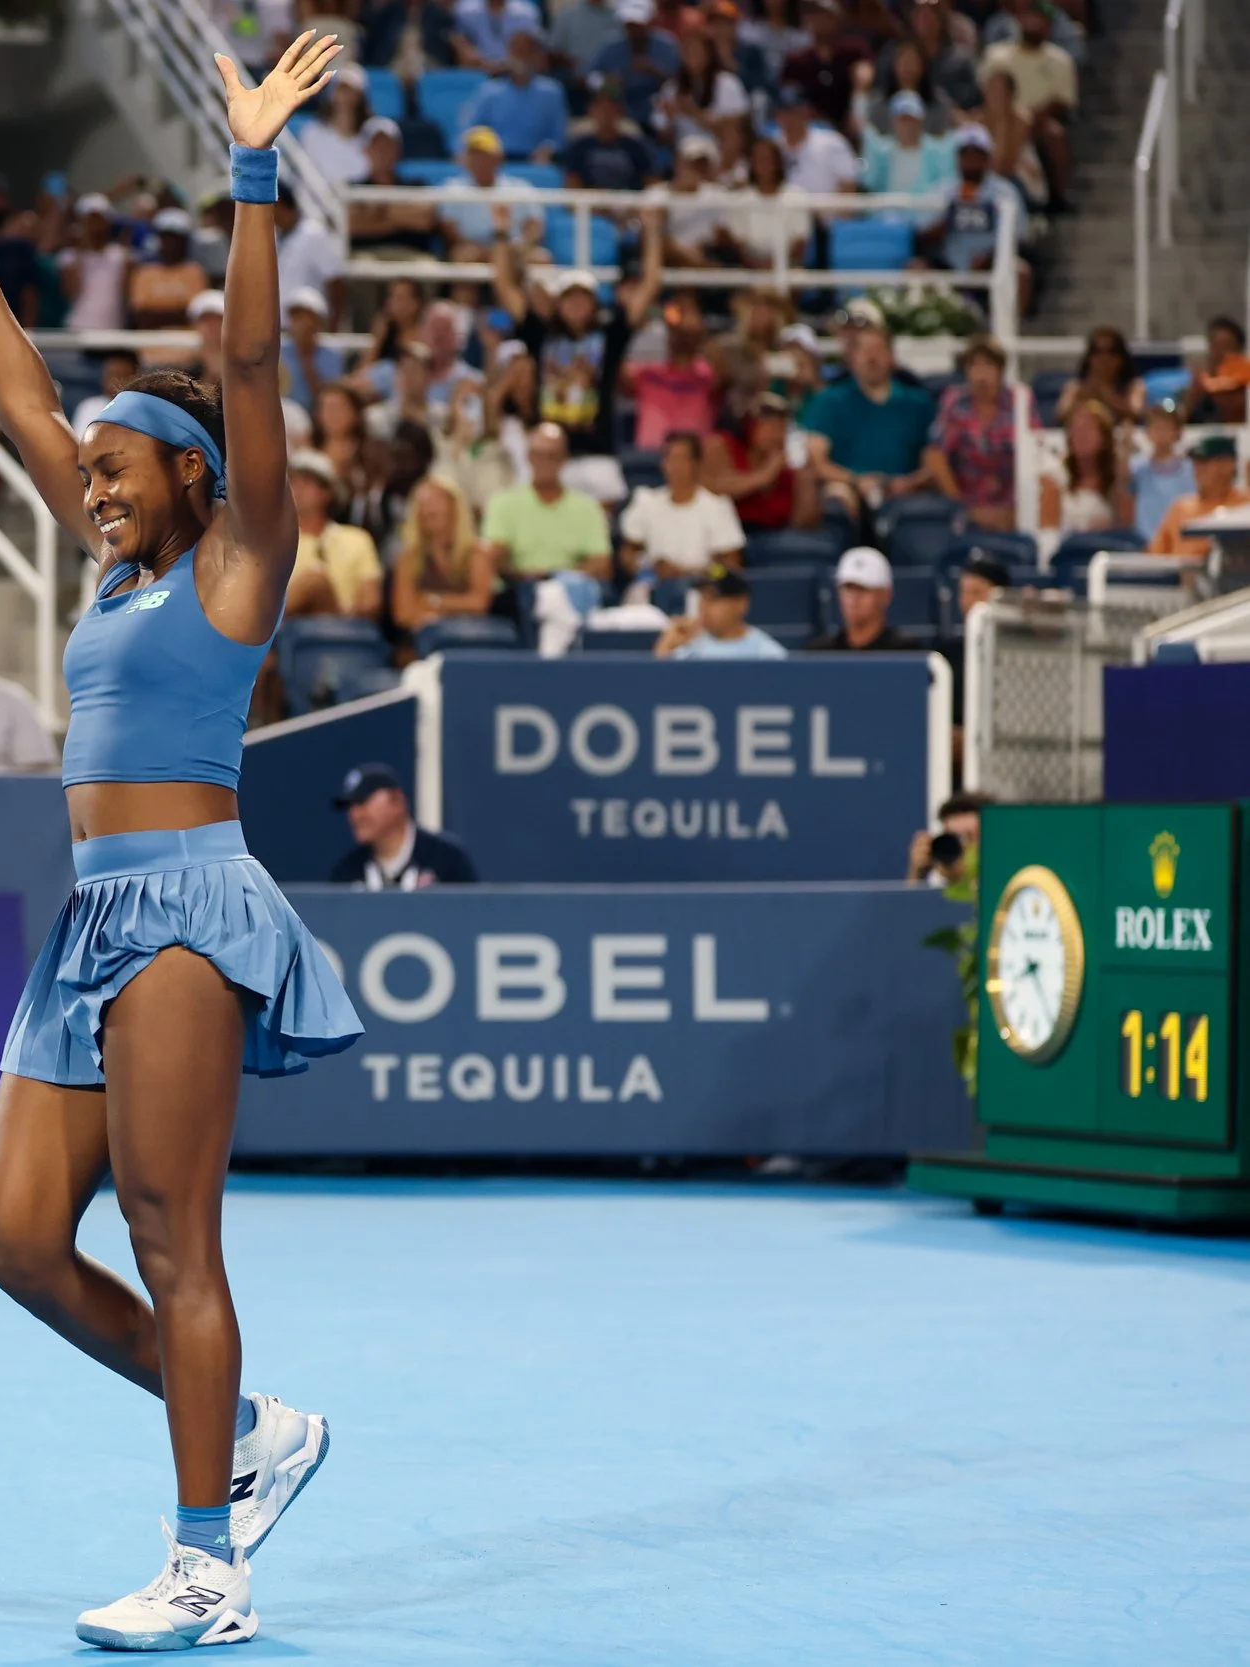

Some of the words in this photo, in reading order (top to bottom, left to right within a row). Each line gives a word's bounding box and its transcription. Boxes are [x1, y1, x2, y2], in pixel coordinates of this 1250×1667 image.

[495, 704, 867, 776] DOBEL
[572, 799, 789, 840] TEQUILA
[1115, 906, 1212, 951] ROLEX
[318, 933, 769, 1023] OBEL
[363, 1054, 663, 1102] TEQUILA
[1121, 1009, 1209, 1103] 1:14
